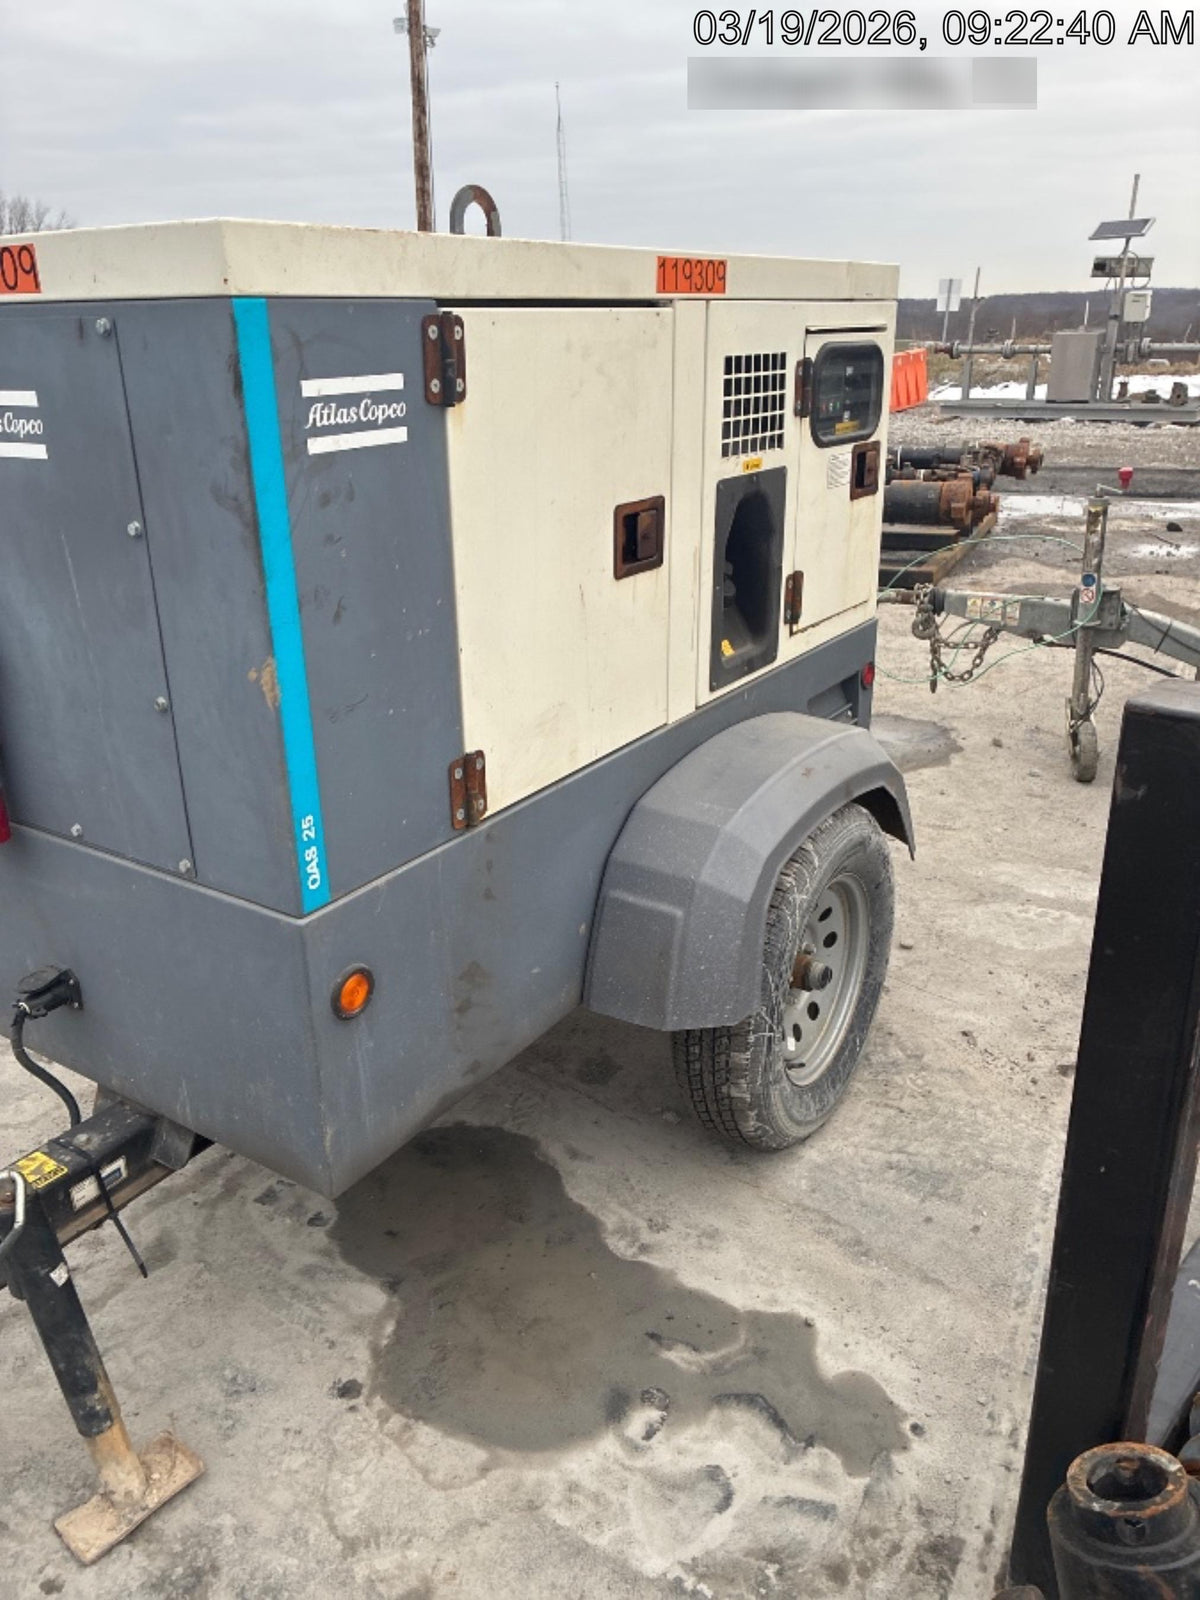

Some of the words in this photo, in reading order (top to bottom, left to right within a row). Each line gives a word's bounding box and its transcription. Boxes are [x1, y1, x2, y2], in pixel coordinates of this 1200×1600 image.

[658, 258, 726, 293] 119309
[3, 411, 44, 439] Copco
[304, 402, 358, 430] Atlas
[359, 398, 407, 425] Copco
[302, 814, 316, 842] 25
